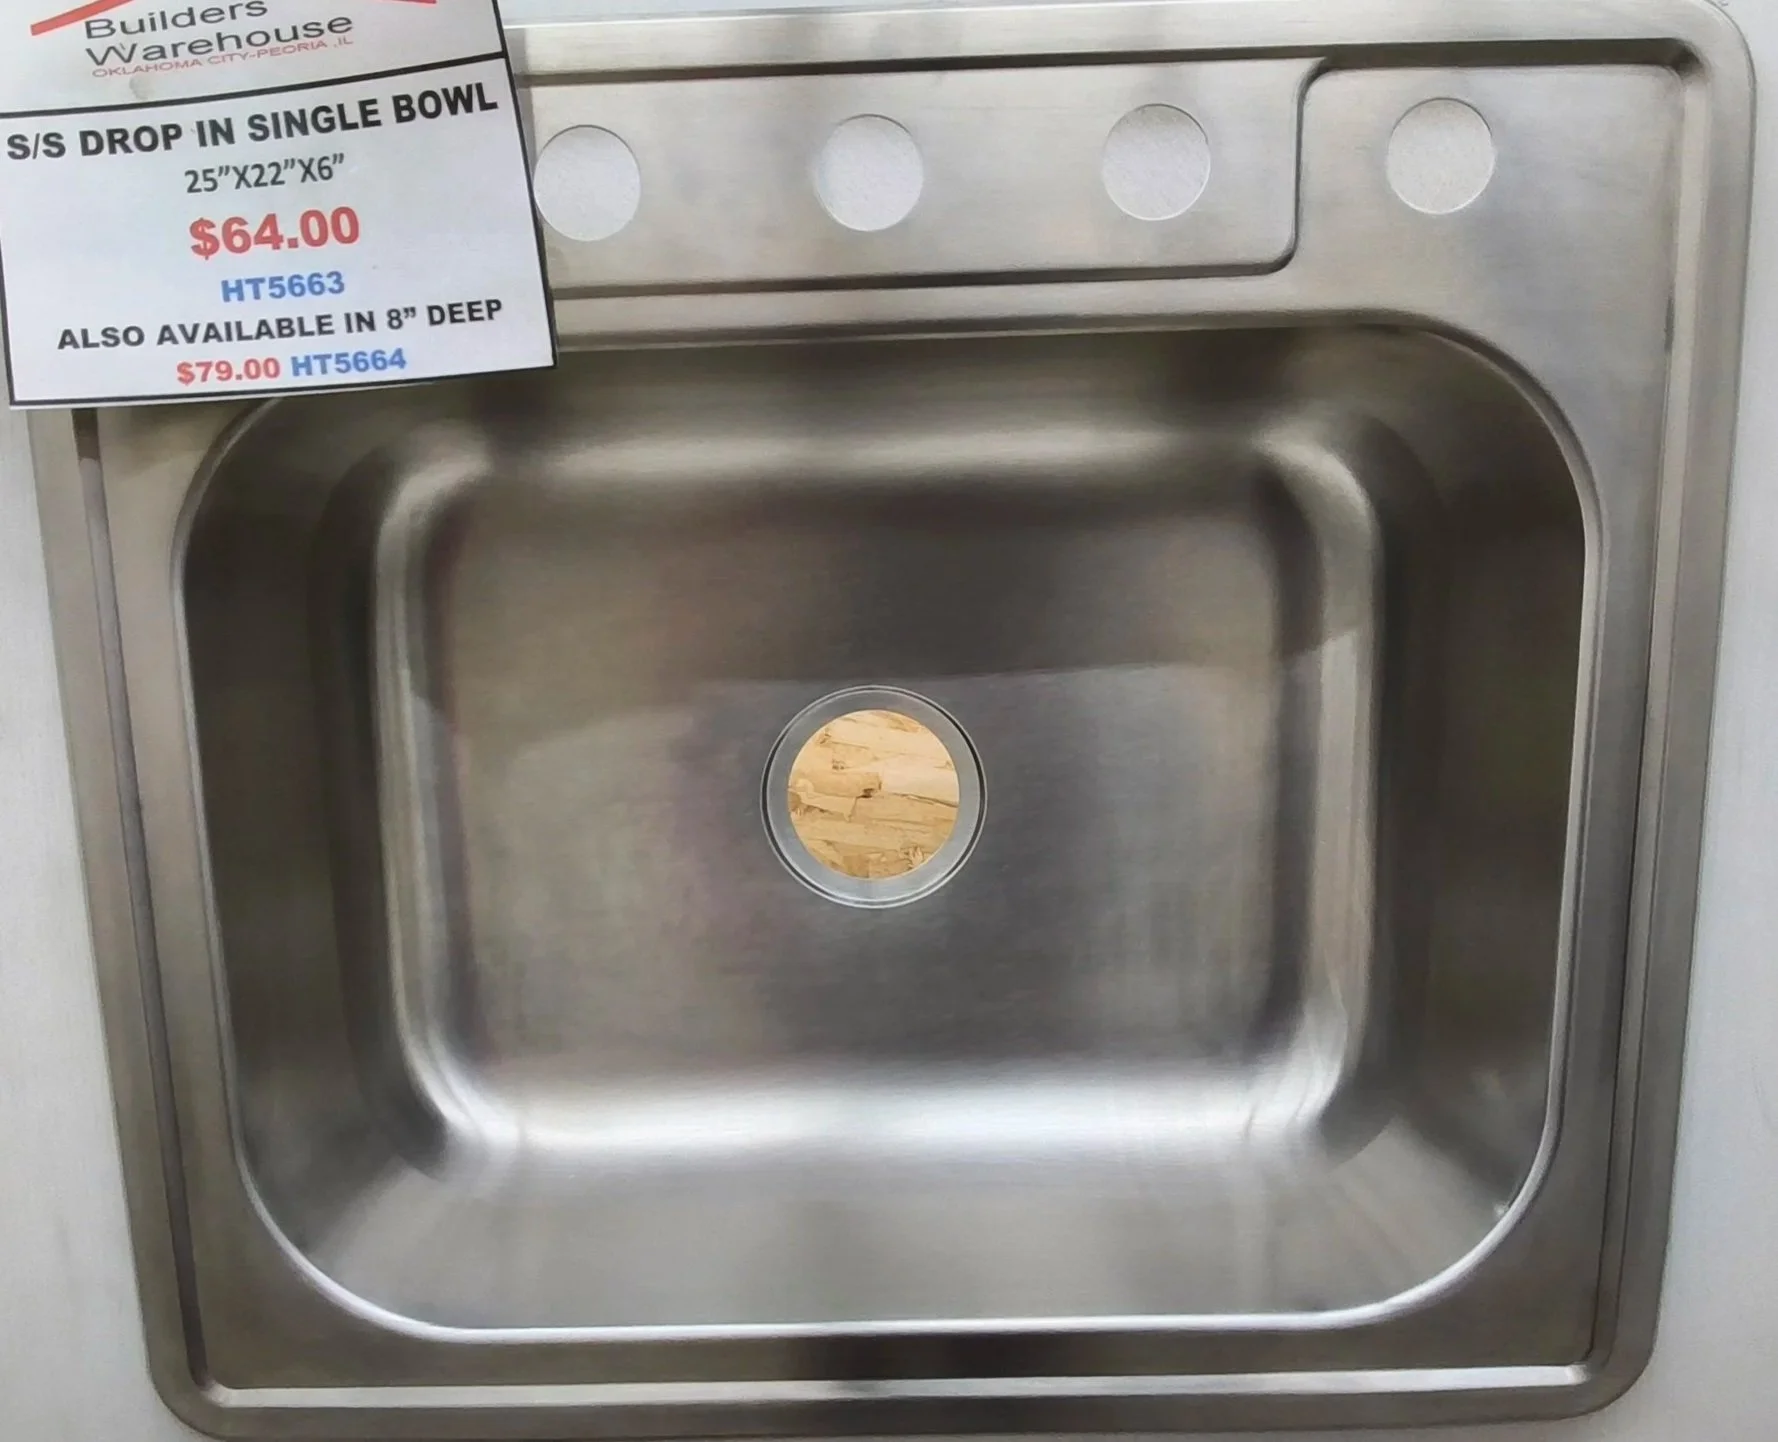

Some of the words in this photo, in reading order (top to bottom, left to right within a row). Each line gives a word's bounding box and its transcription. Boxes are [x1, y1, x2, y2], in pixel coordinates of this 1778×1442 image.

[85, 0, 268, 39] Builders
[86, 15, 353, 66] Warehouse
[92, 59, 202, 78] OKLAHOMA
[207, 39, 327, 65] CITY-PEORIA
[6, 133, 66, 160] S/S
[79, 123, 183, 156] DROP
[197, 117, 235, 147] IN
[247, 100, 381, 140] SINGLE
[393, 82, 498, 123] BOWL
[189, 206, 360, 259] $64.00
[221, 271, 345, 302] HT5663
[58, 325, 145, 349] ALSO
[157, 315, 335, 343] AVAILABLE
[346, 311, 376, 334] IN
[387, 307, 416, 331] 8”
[428, 299, 502, 325] DEEP
[176, 357, 281, 384] $79.00
[291, 348, 406, 377] HT5664
